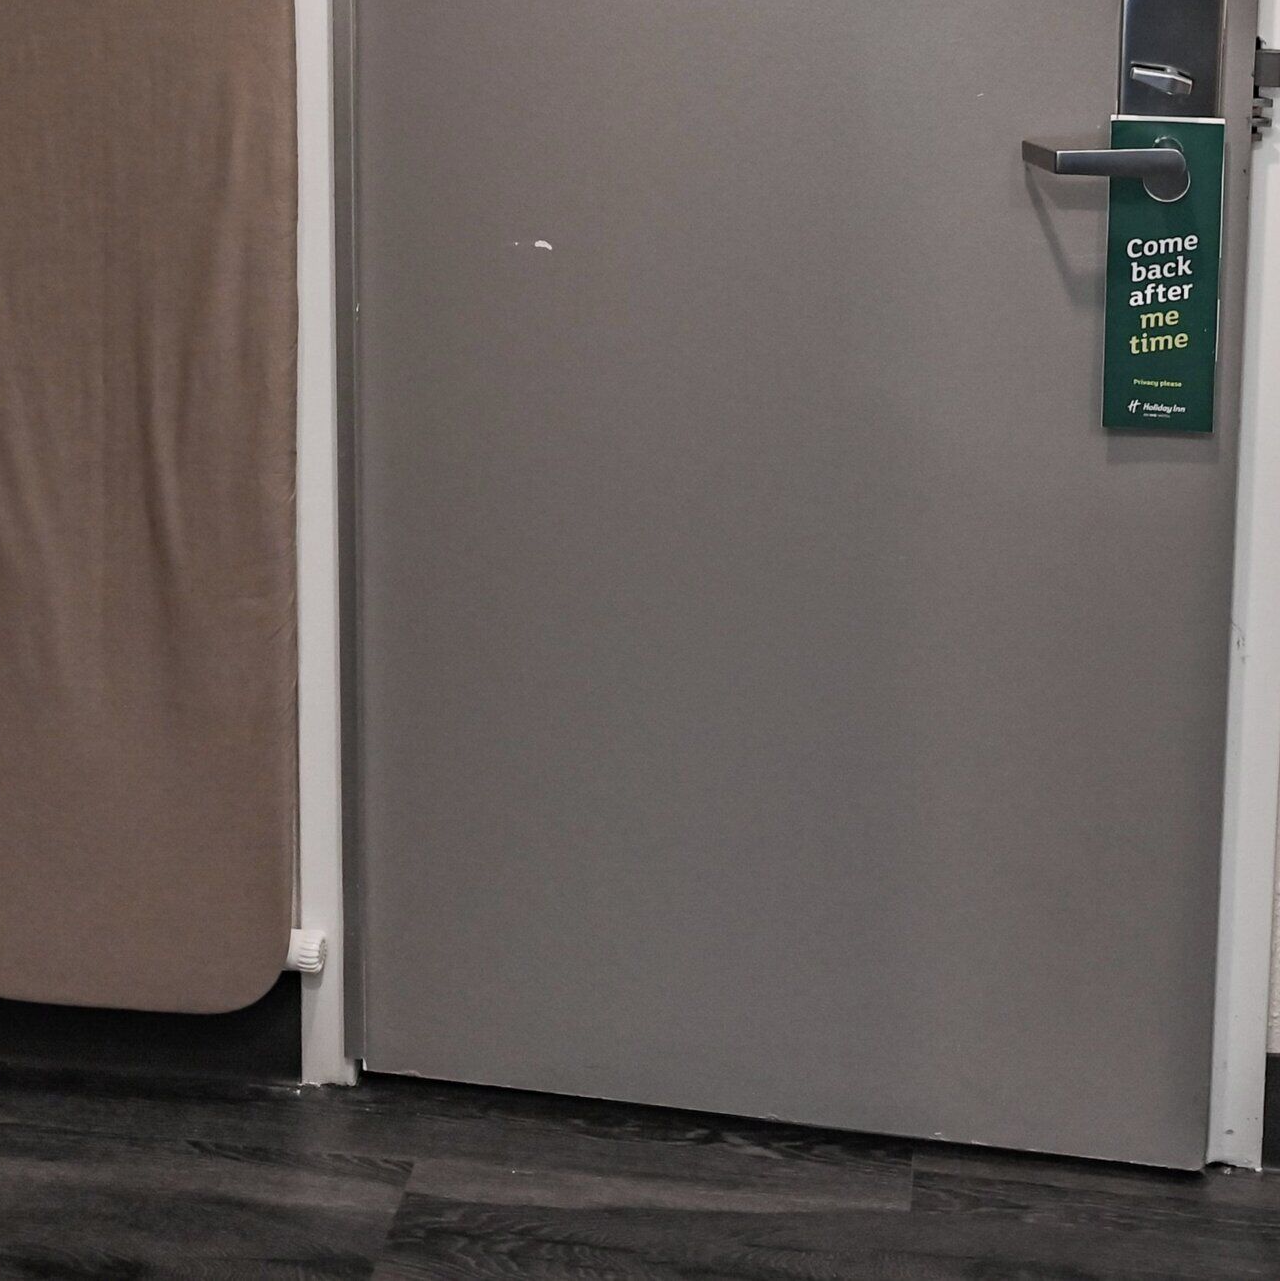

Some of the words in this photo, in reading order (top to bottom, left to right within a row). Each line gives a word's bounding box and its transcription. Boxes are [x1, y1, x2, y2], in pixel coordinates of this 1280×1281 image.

[1127, 235, 1198, 258] Come
[1131, 256, 1193, 282] back
[1129, 283, 1193, 306] after
[1140, 310, 1179, 329] me
[1129, 332, 1188, 354] time
[1133, 379, 1158, 387] Privacy
[1143, 403, 1173, 414] Holiday
[1173, 404, 1186, 413] Inn
